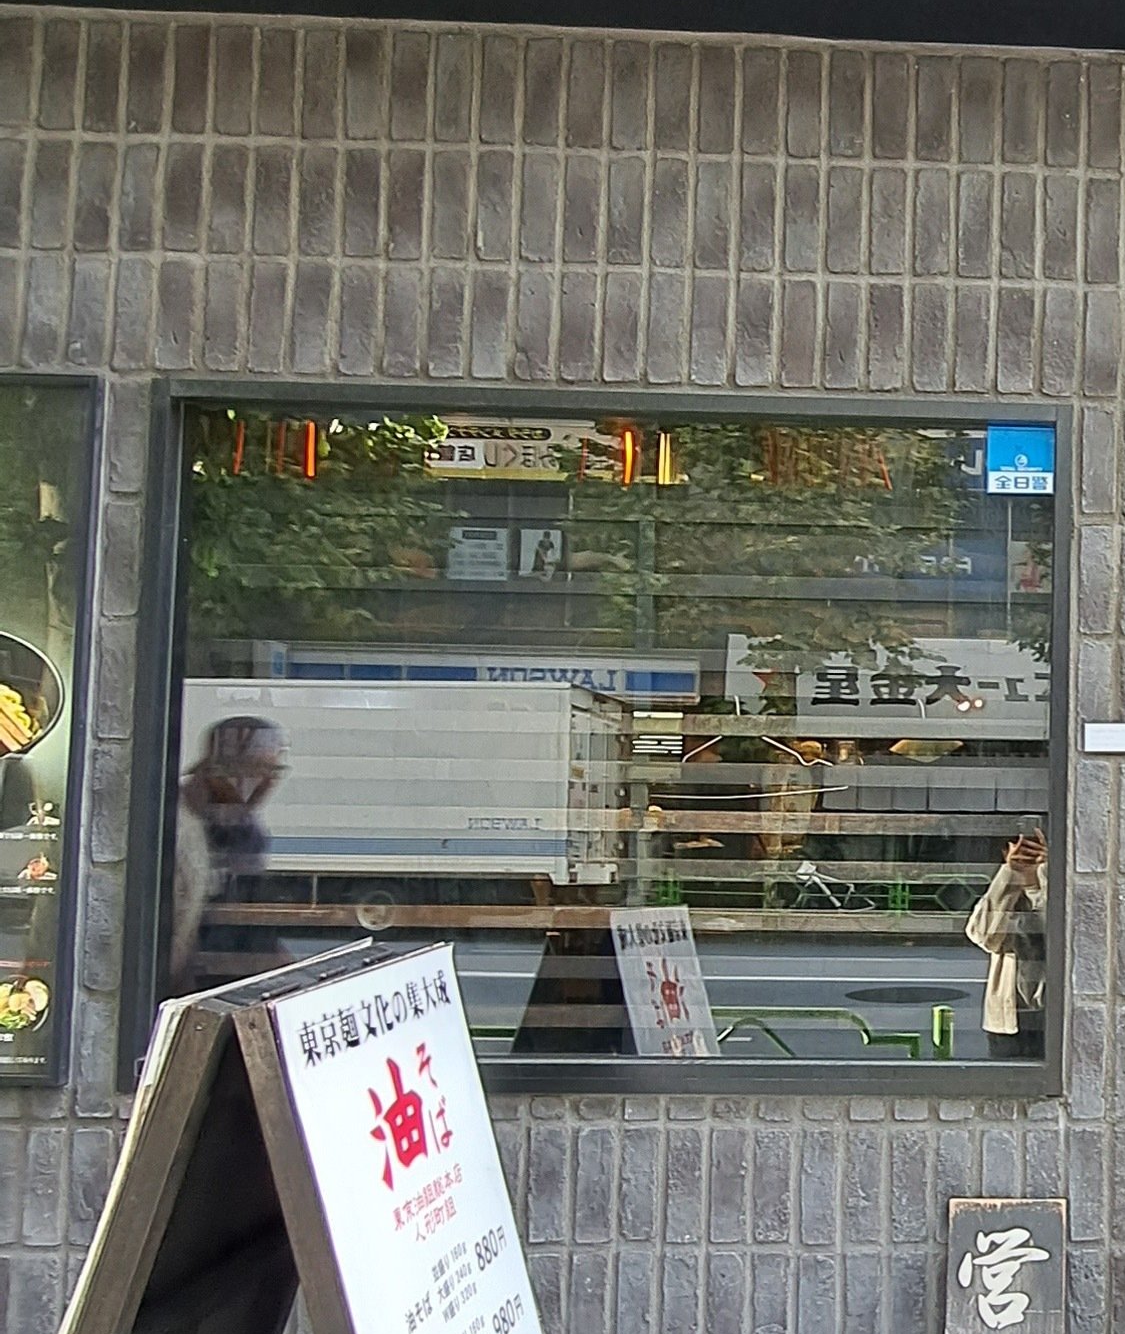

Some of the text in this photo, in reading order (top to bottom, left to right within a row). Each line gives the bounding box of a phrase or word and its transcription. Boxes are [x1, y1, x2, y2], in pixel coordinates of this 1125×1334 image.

[994, 475, 1049, 491] 全日警
[299, 969, 451, 1068] 東京麺文化の集大成
[475, 1225, 507, 1271] 880円
